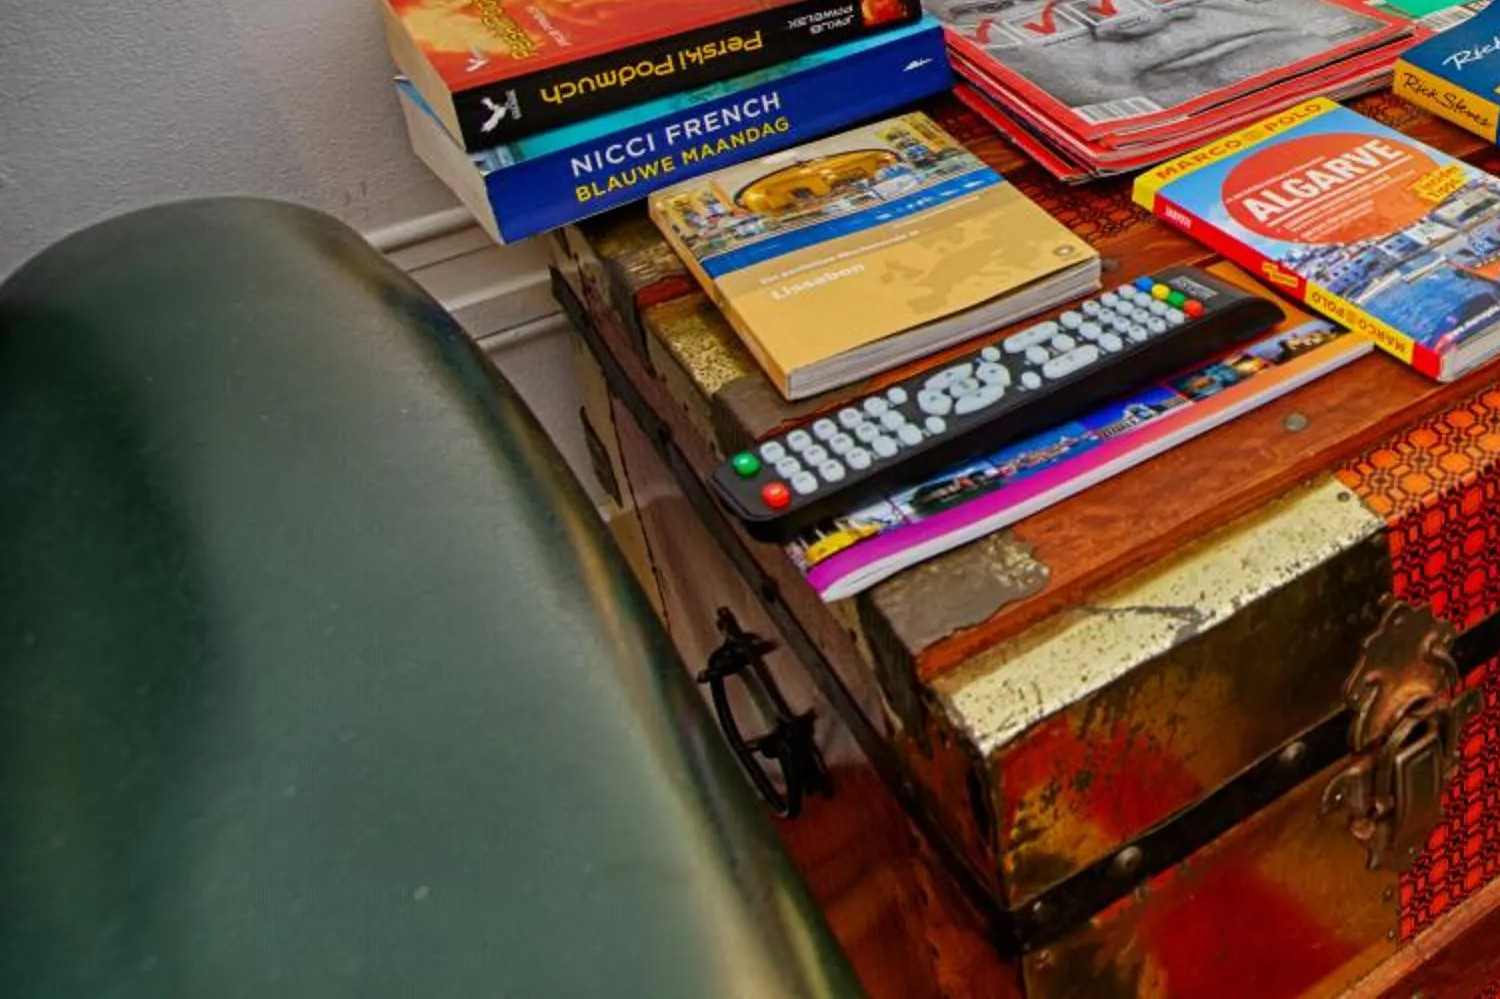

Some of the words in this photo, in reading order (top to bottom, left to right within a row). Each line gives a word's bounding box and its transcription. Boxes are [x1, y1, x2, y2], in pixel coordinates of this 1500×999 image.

[540, 55, 673, 104] Podmuch
[680, 30, 764, 69] Perski
[571, 133, 655, 177] NICCI
[665, 92, 780, 146] FRENCH
[575, 156, 675, 202] BLAUWE
[681, 116, 791, 164] MAANDAG
[1156, 140, 1242, 180] MARCO
[1264, 104, 1321, 132] POLO
[1242, 139, 1404, 222] ALGARVE
[1311, 291, 1346, 320] POLO
[1358, 317, 1406, 353] MARCO
